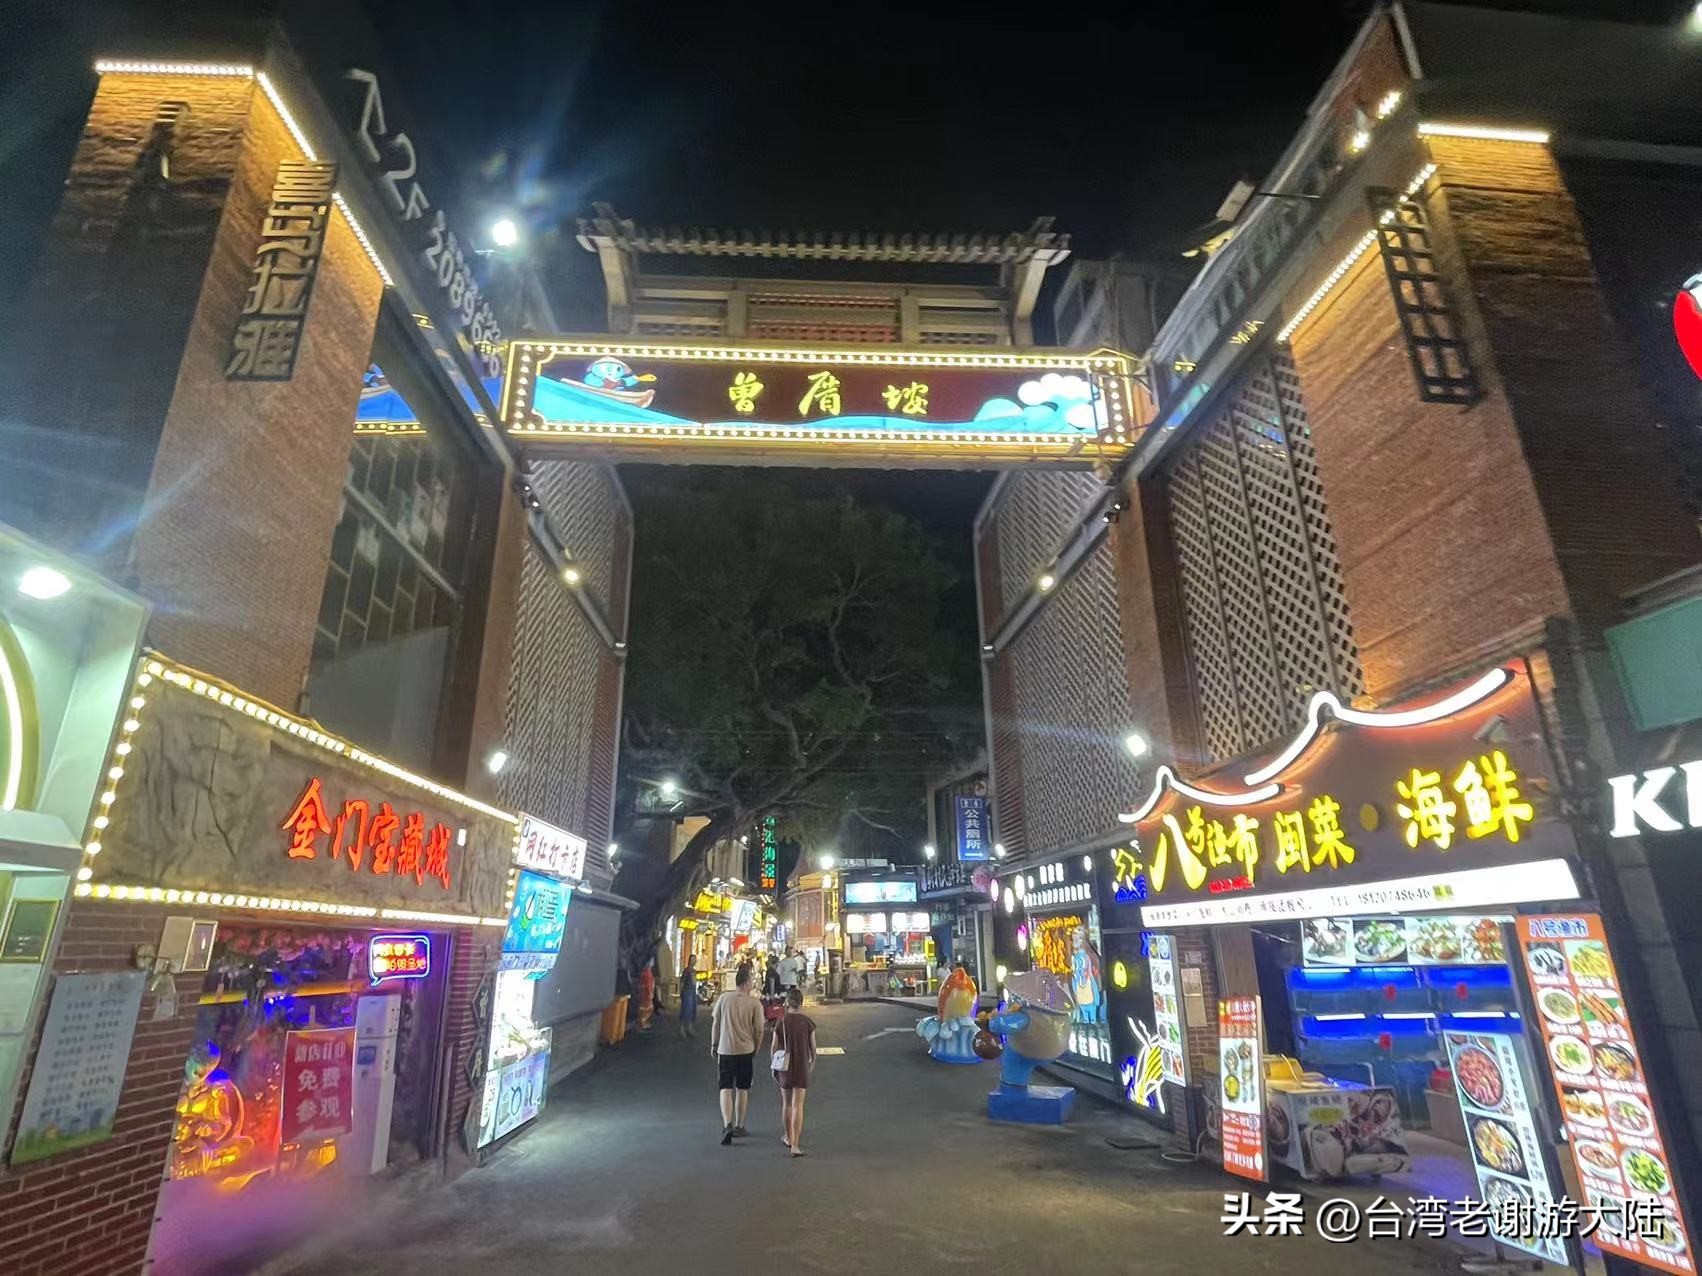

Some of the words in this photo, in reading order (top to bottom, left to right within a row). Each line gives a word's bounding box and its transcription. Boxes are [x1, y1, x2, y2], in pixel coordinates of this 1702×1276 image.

[1398, 750, 1533, 851] 海鲜
[282, 777, 451, 890] 金门宝藏城
[964, 808, 981, 849] 公共厕所
[298, 1066, 341, 1092] 免费
[296, 1096, 341, 1122] 参观
